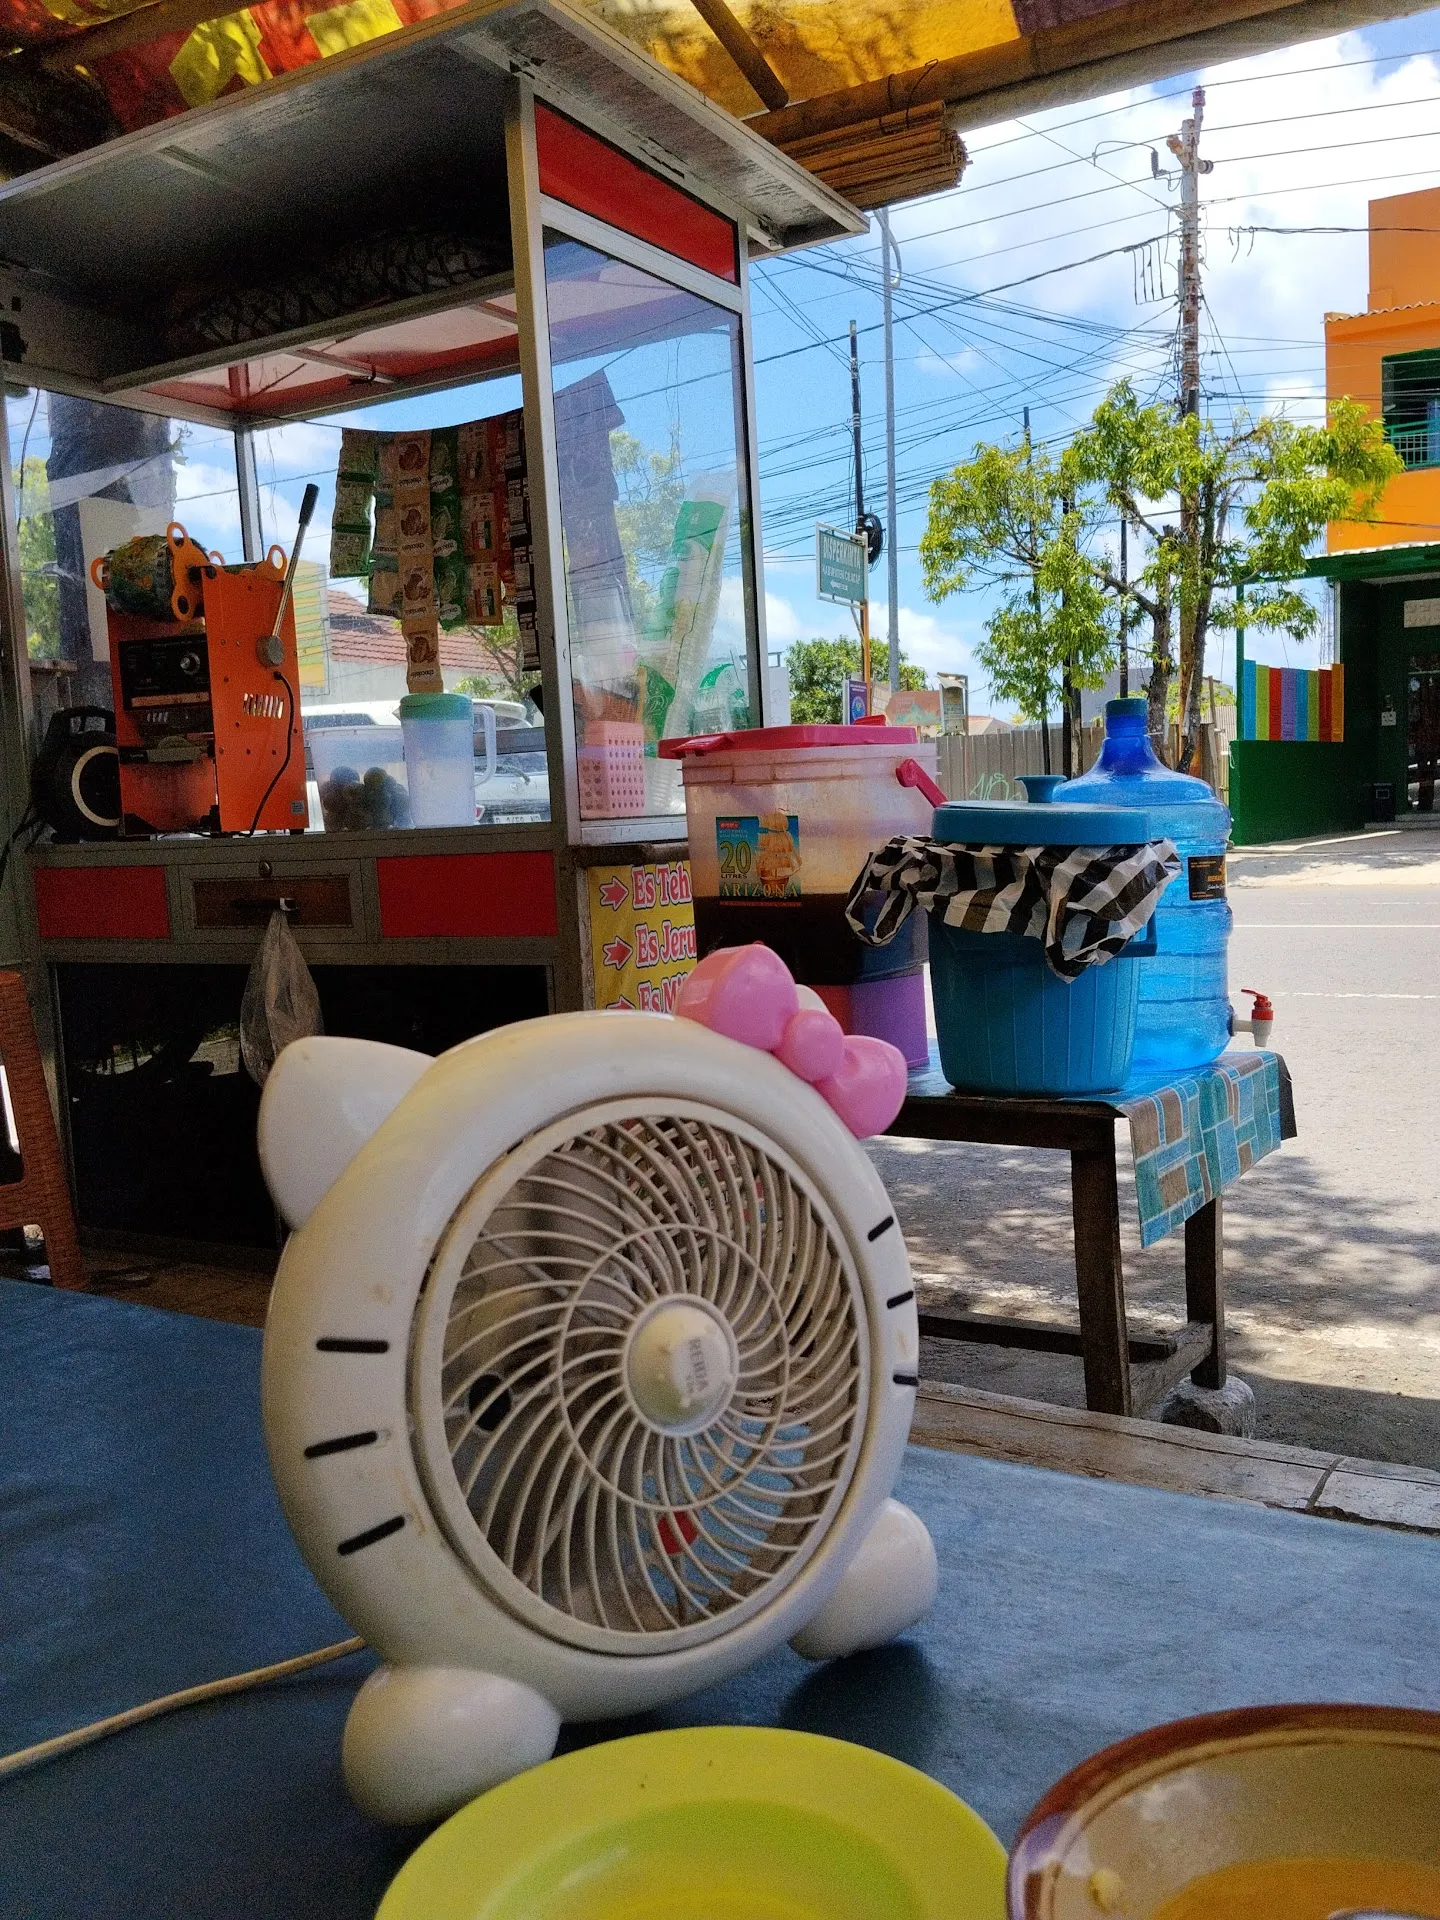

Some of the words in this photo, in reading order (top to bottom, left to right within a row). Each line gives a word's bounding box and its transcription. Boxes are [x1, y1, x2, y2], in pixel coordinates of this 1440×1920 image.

[720, 841, 752, 875] 20
[632, 866, 656, 910] Es
[656, 861, 692, 905] Teh
[721, 882, 799, 897] ARIZONA
[635, 923, 659, 968] Es
[638, 980, 662, 1012] Es
